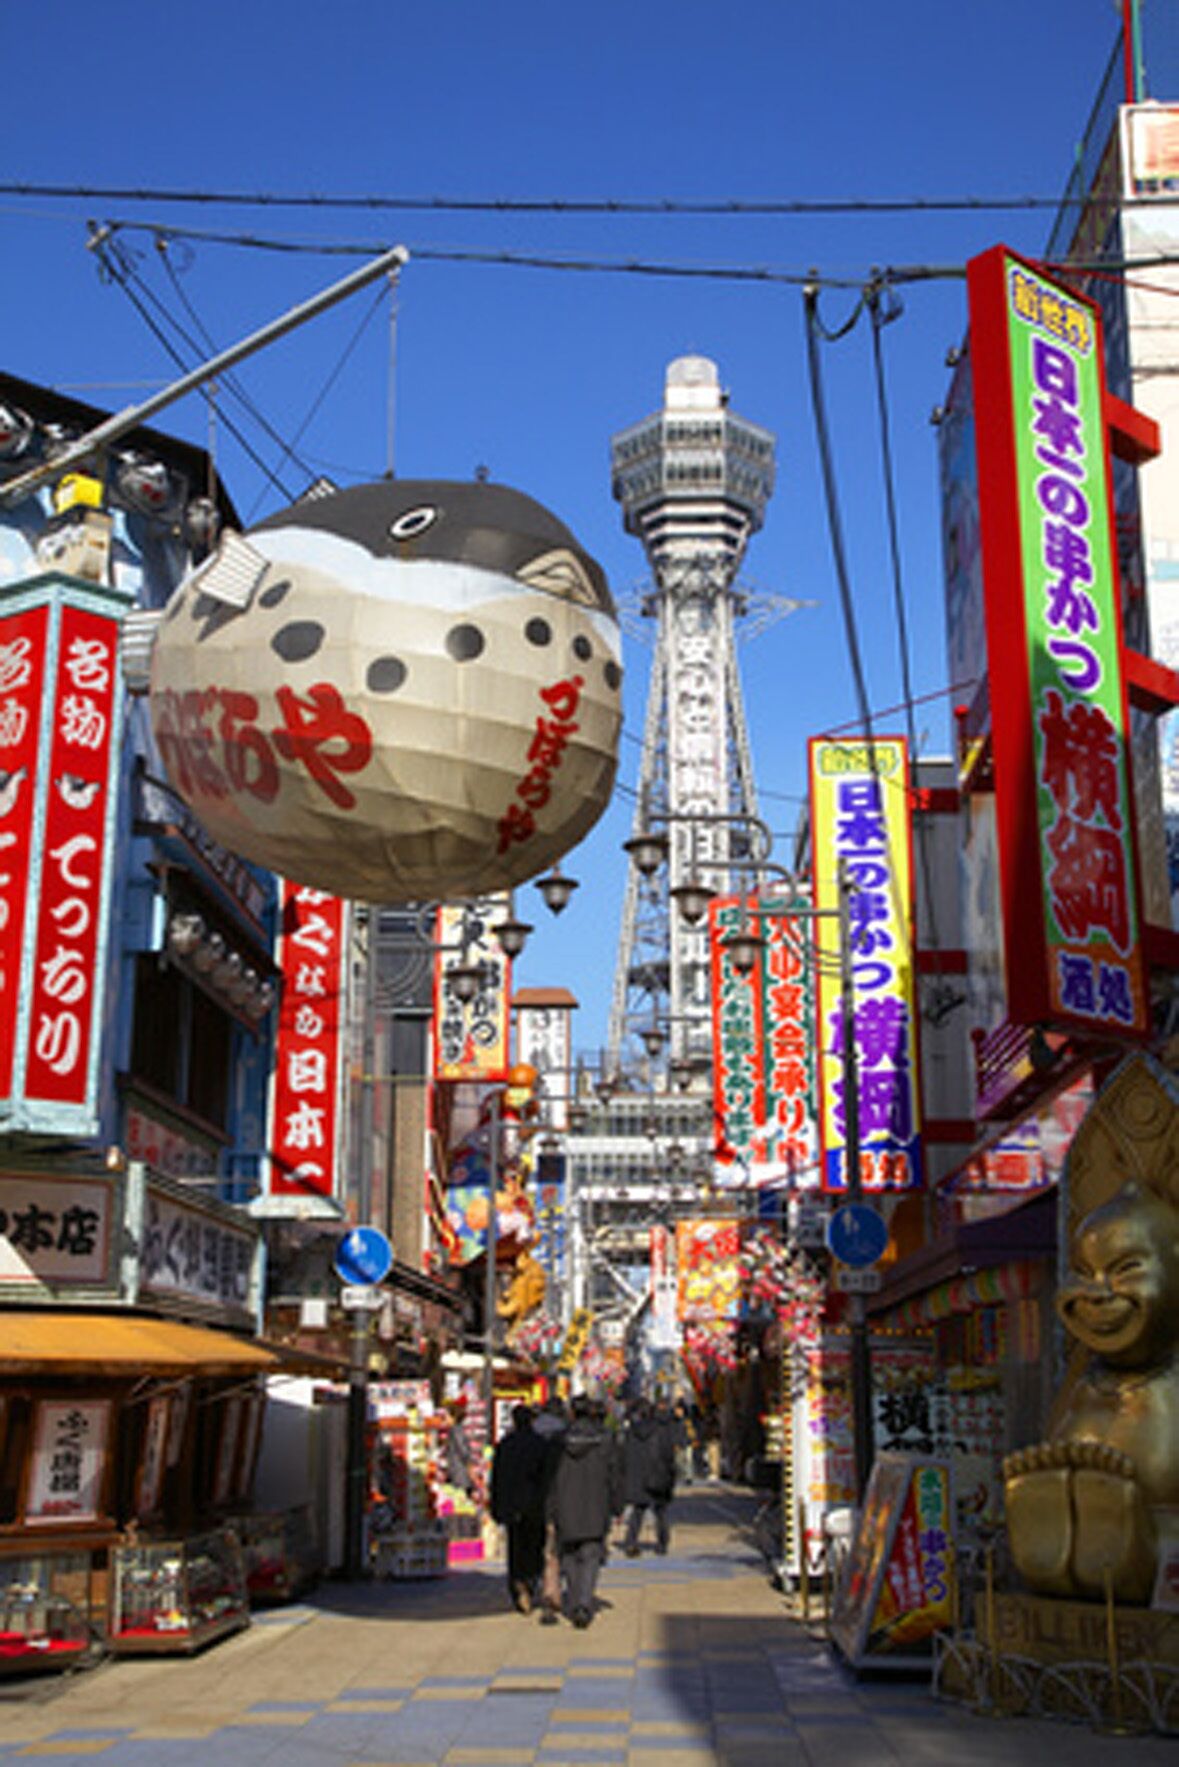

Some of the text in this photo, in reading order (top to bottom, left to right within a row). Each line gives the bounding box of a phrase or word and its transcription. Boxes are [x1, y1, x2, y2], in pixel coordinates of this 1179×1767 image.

[60, 637, 109, 751] 名物
[36, 833, 97, 1075] てっちり
[0, 1203, 98, 1255] 本店
